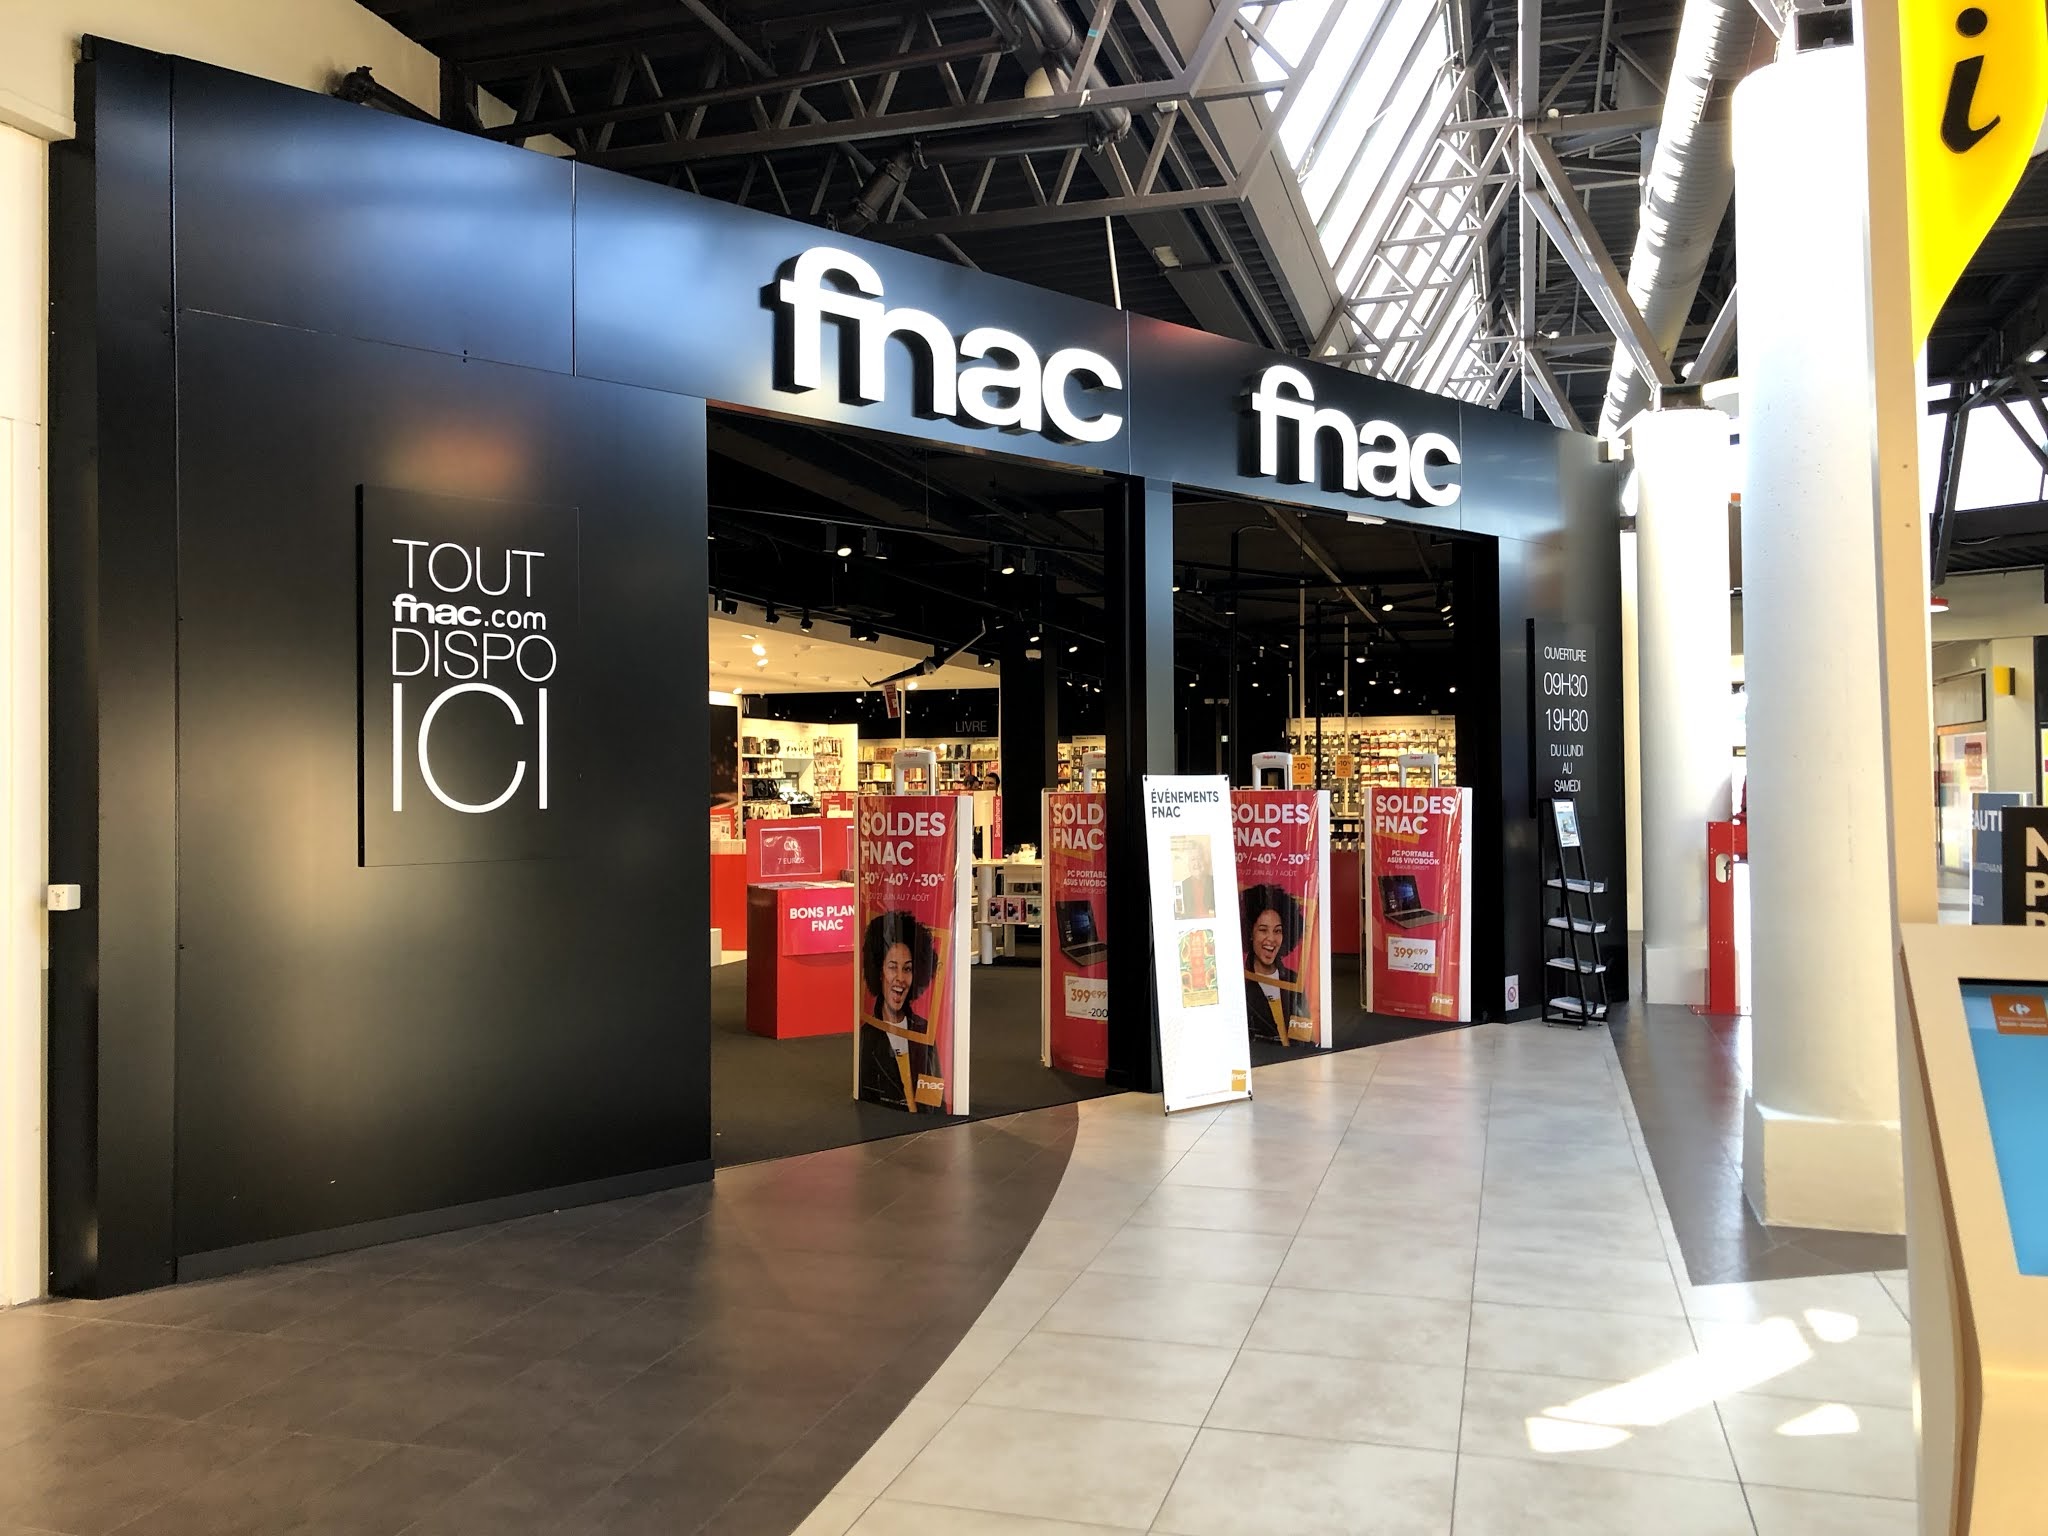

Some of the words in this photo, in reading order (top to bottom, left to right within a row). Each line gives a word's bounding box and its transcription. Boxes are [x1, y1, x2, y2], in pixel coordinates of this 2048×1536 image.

[779, 246, 1124, 443] fnac
[1252, 364, 1462, 508] fnac
[392, 538, 546, 598] TOUT
[392, 592, 547, 631] fnac.com
[392, 627, 557, 683] DISPO
[1543, 646, 1587, 663] OUVERTURE
[1543, 671, 1588, 698] 09H30
[955, 720, 988, 733] LIVRE
[1545, 708, 1589, 733] 19H30
[392, 682, 548, 814] ICI
[1550, 744, 1562, 757] DU
[1563, 744, 1584, 757] LUNDI
[1562, 762, 1573, 775] AU
[1554, 779, 1581, 793] SAMEDI
[1150, 788, 1220, 804] ÉVÉNEMENTS
[1151, 805, 1181, 819] FNAC
[1375, 795, 1456, 815] SOLDES
[861, 811, 946, 837] SOLDES
[1375, 815, 1429, 835] FNAC
[1053, 828, 1104, 851] FNAC
[861, 840, 915, 866] FNAC
[1391, 849, 1400, 857] PC
[1401, 850, 1434, 858] PORTABLE
[1404, 857, 1440, 866] VIVOBOOK
[1067, 869, 1075, 877] PC
[1063, 878, 1078, 886] ASUS
[790, 906, 824, 919] BONS
[811, 919, 844, 932] FNAC
[1431, 995, 1454, 1005] fnac
[1289, 1020, 1313, 1029] fnac
[917, 1079, 945, 1090] fnac
